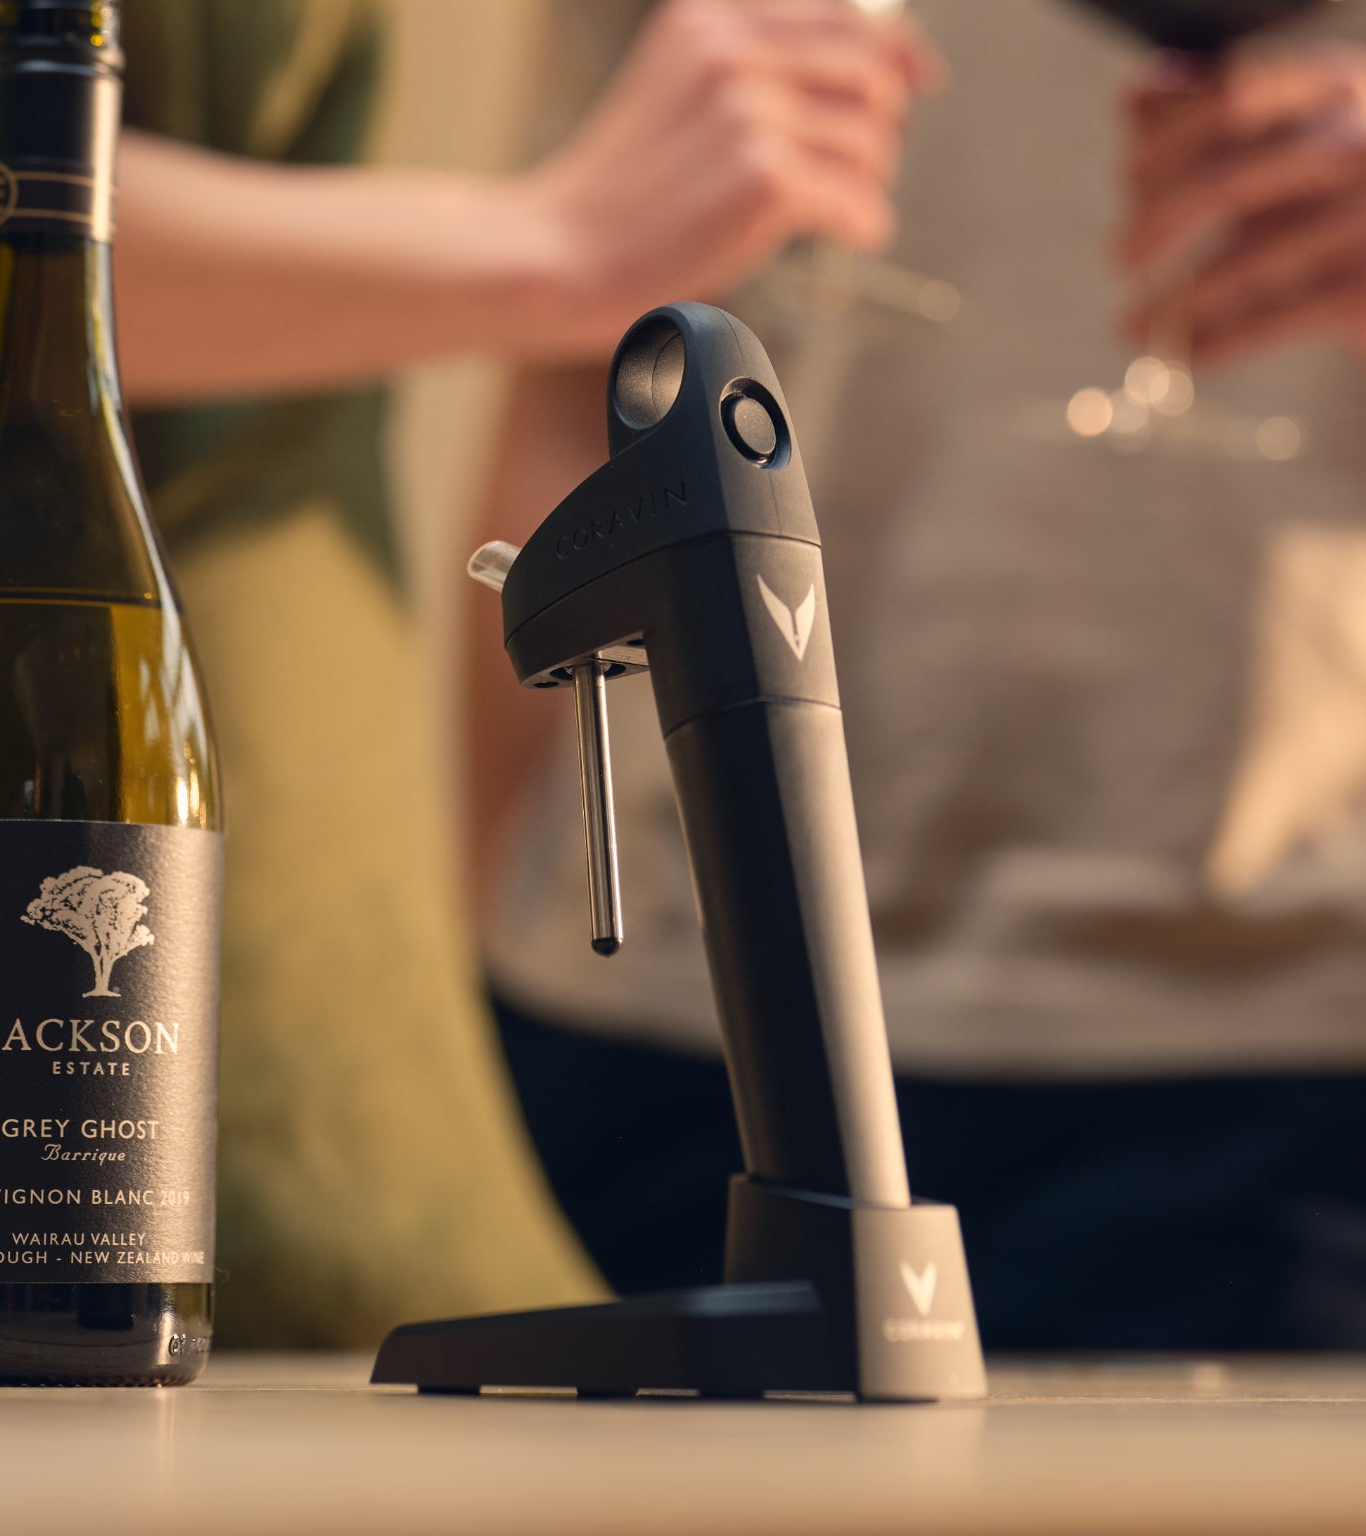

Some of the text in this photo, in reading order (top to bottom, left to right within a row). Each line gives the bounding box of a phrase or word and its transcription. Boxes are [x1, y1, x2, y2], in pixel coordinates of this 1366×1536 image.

[556, 480, 687, 559] CORAVIN
[52, 1061, 131, 1076] ESTATE
[1, 1118, 159, 1140] GREY GHOST
[41, 1143, 126, 1166] Barrique
[91, 1189, 154, 1205] BLANC
[160, 1190, 190, 1206] 2019
[11, 1232, 147, 1246] WAIRAU VALLEY
[70, 1251, 110, 1264] NEW
[116, 1251, 180, 1265] ZEALAND
[180, 1251, 205, 1265] WINE
